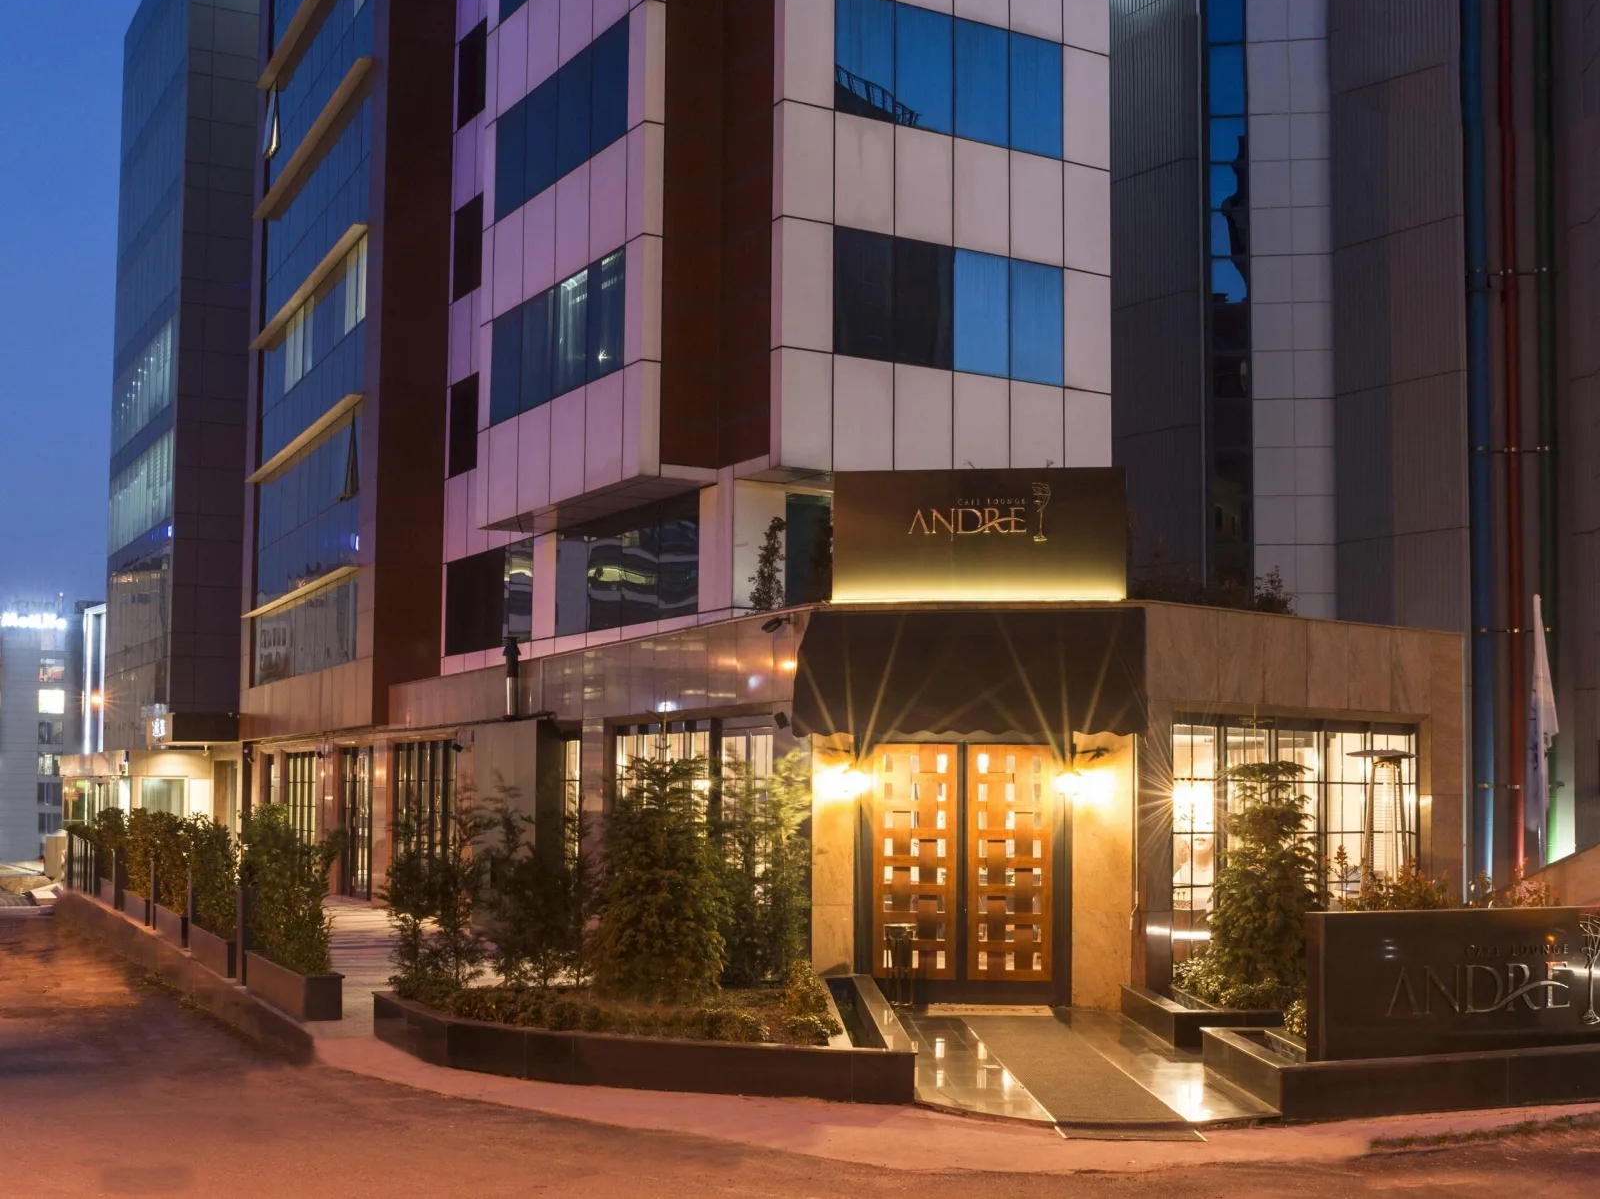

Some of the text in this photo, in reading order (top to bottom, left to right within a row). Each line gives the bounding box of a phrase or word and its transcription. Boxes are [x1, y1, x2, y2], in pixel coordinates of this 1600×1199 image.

[957, 497, 1027, 506] CAFE LOUNGE
[907, 507, 1027, 537] ANDRE
[1385, 961, 1571, 1017] ANDRE
